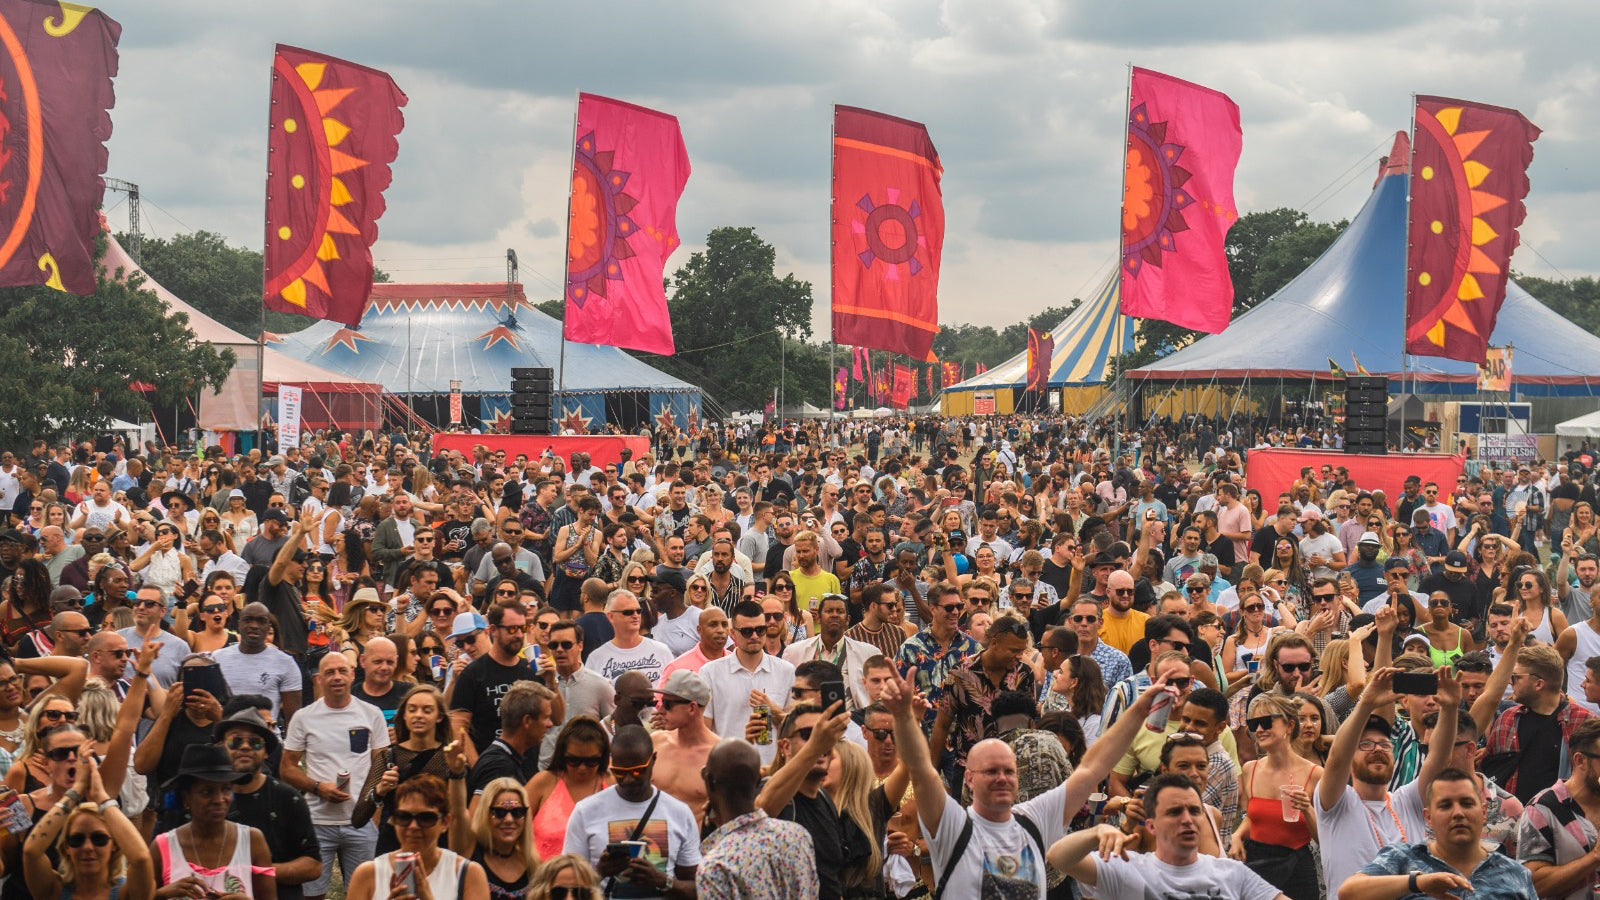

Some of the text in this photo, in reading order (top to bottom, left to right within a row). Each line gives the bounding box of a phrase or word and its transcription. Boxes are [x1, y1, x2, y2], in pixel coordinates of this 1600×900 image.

[1484, 358, 1505, 380] BAR
[1480, 447, 1535, 457] GRANT NELSON
